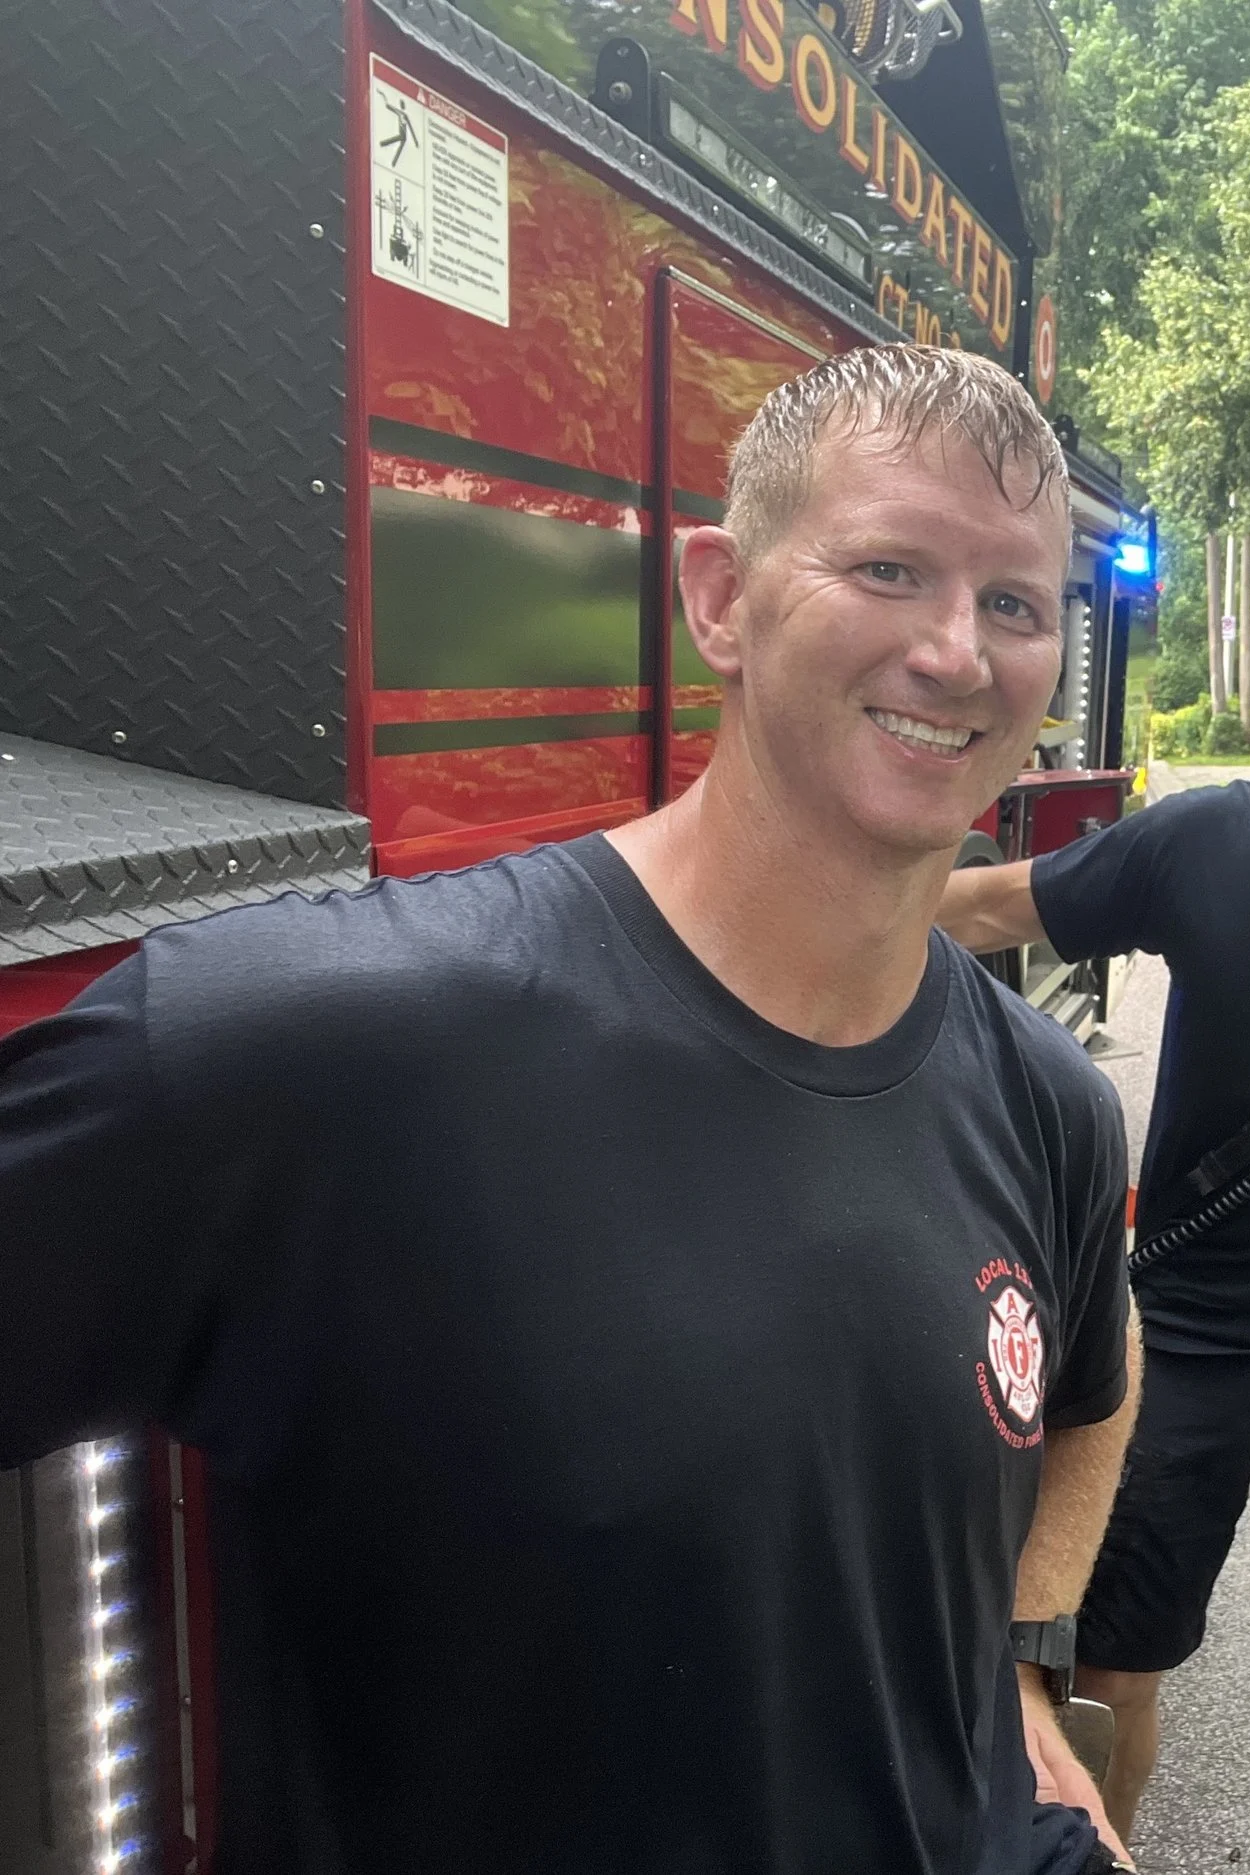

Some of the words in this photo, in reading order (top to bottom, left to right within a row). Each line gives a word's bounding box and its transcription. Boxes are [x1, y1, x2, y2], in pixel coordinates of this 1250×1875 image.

[428, 92, 467, 128] DANGER
[975, 1258, 1012, 1292] LOCAL
[975, 1361, 1025, 1449] CONSOLIDATED
